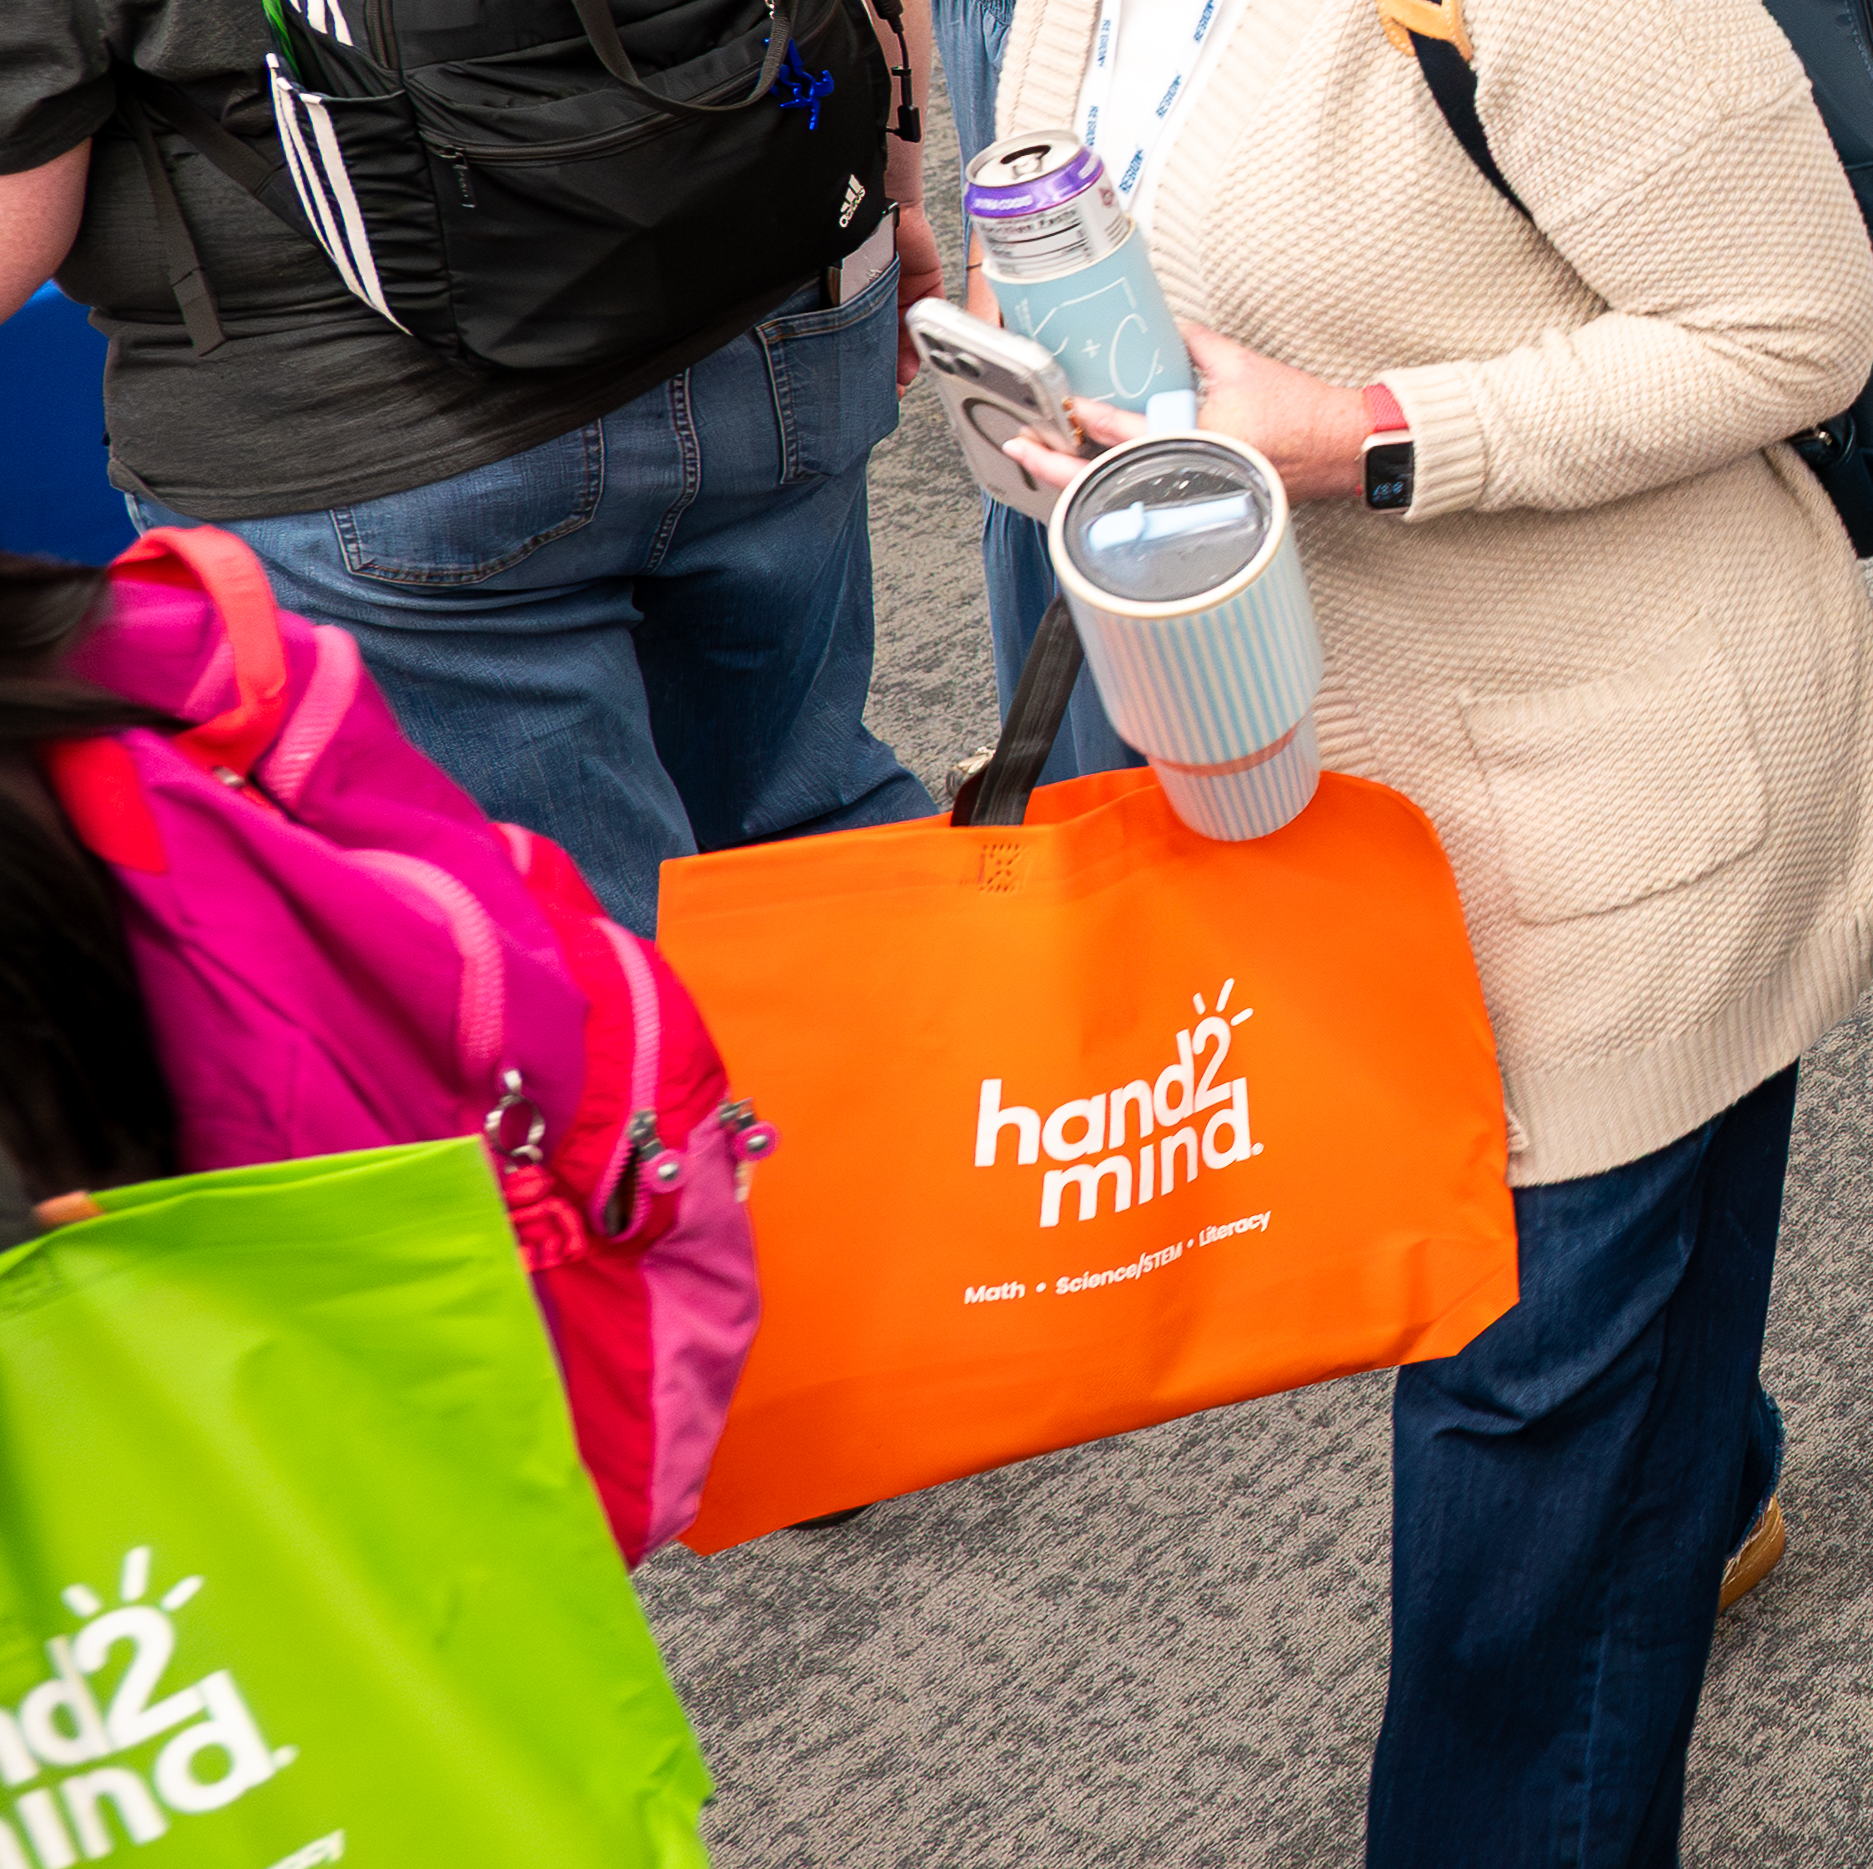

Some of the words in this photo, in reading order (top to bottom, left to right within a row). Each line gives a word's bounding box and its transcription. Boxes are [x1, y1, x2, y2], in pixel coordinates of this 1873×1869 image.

[974, 1014, 1234, 1170] hand2
[1038, 1076, 1256, 1229] mind
[963, 1278, 1026, 1307] Math
[1054, 1242, 1184, 1298] Science/STEM
[1198, 1209, 1273, 1250] Literacy
